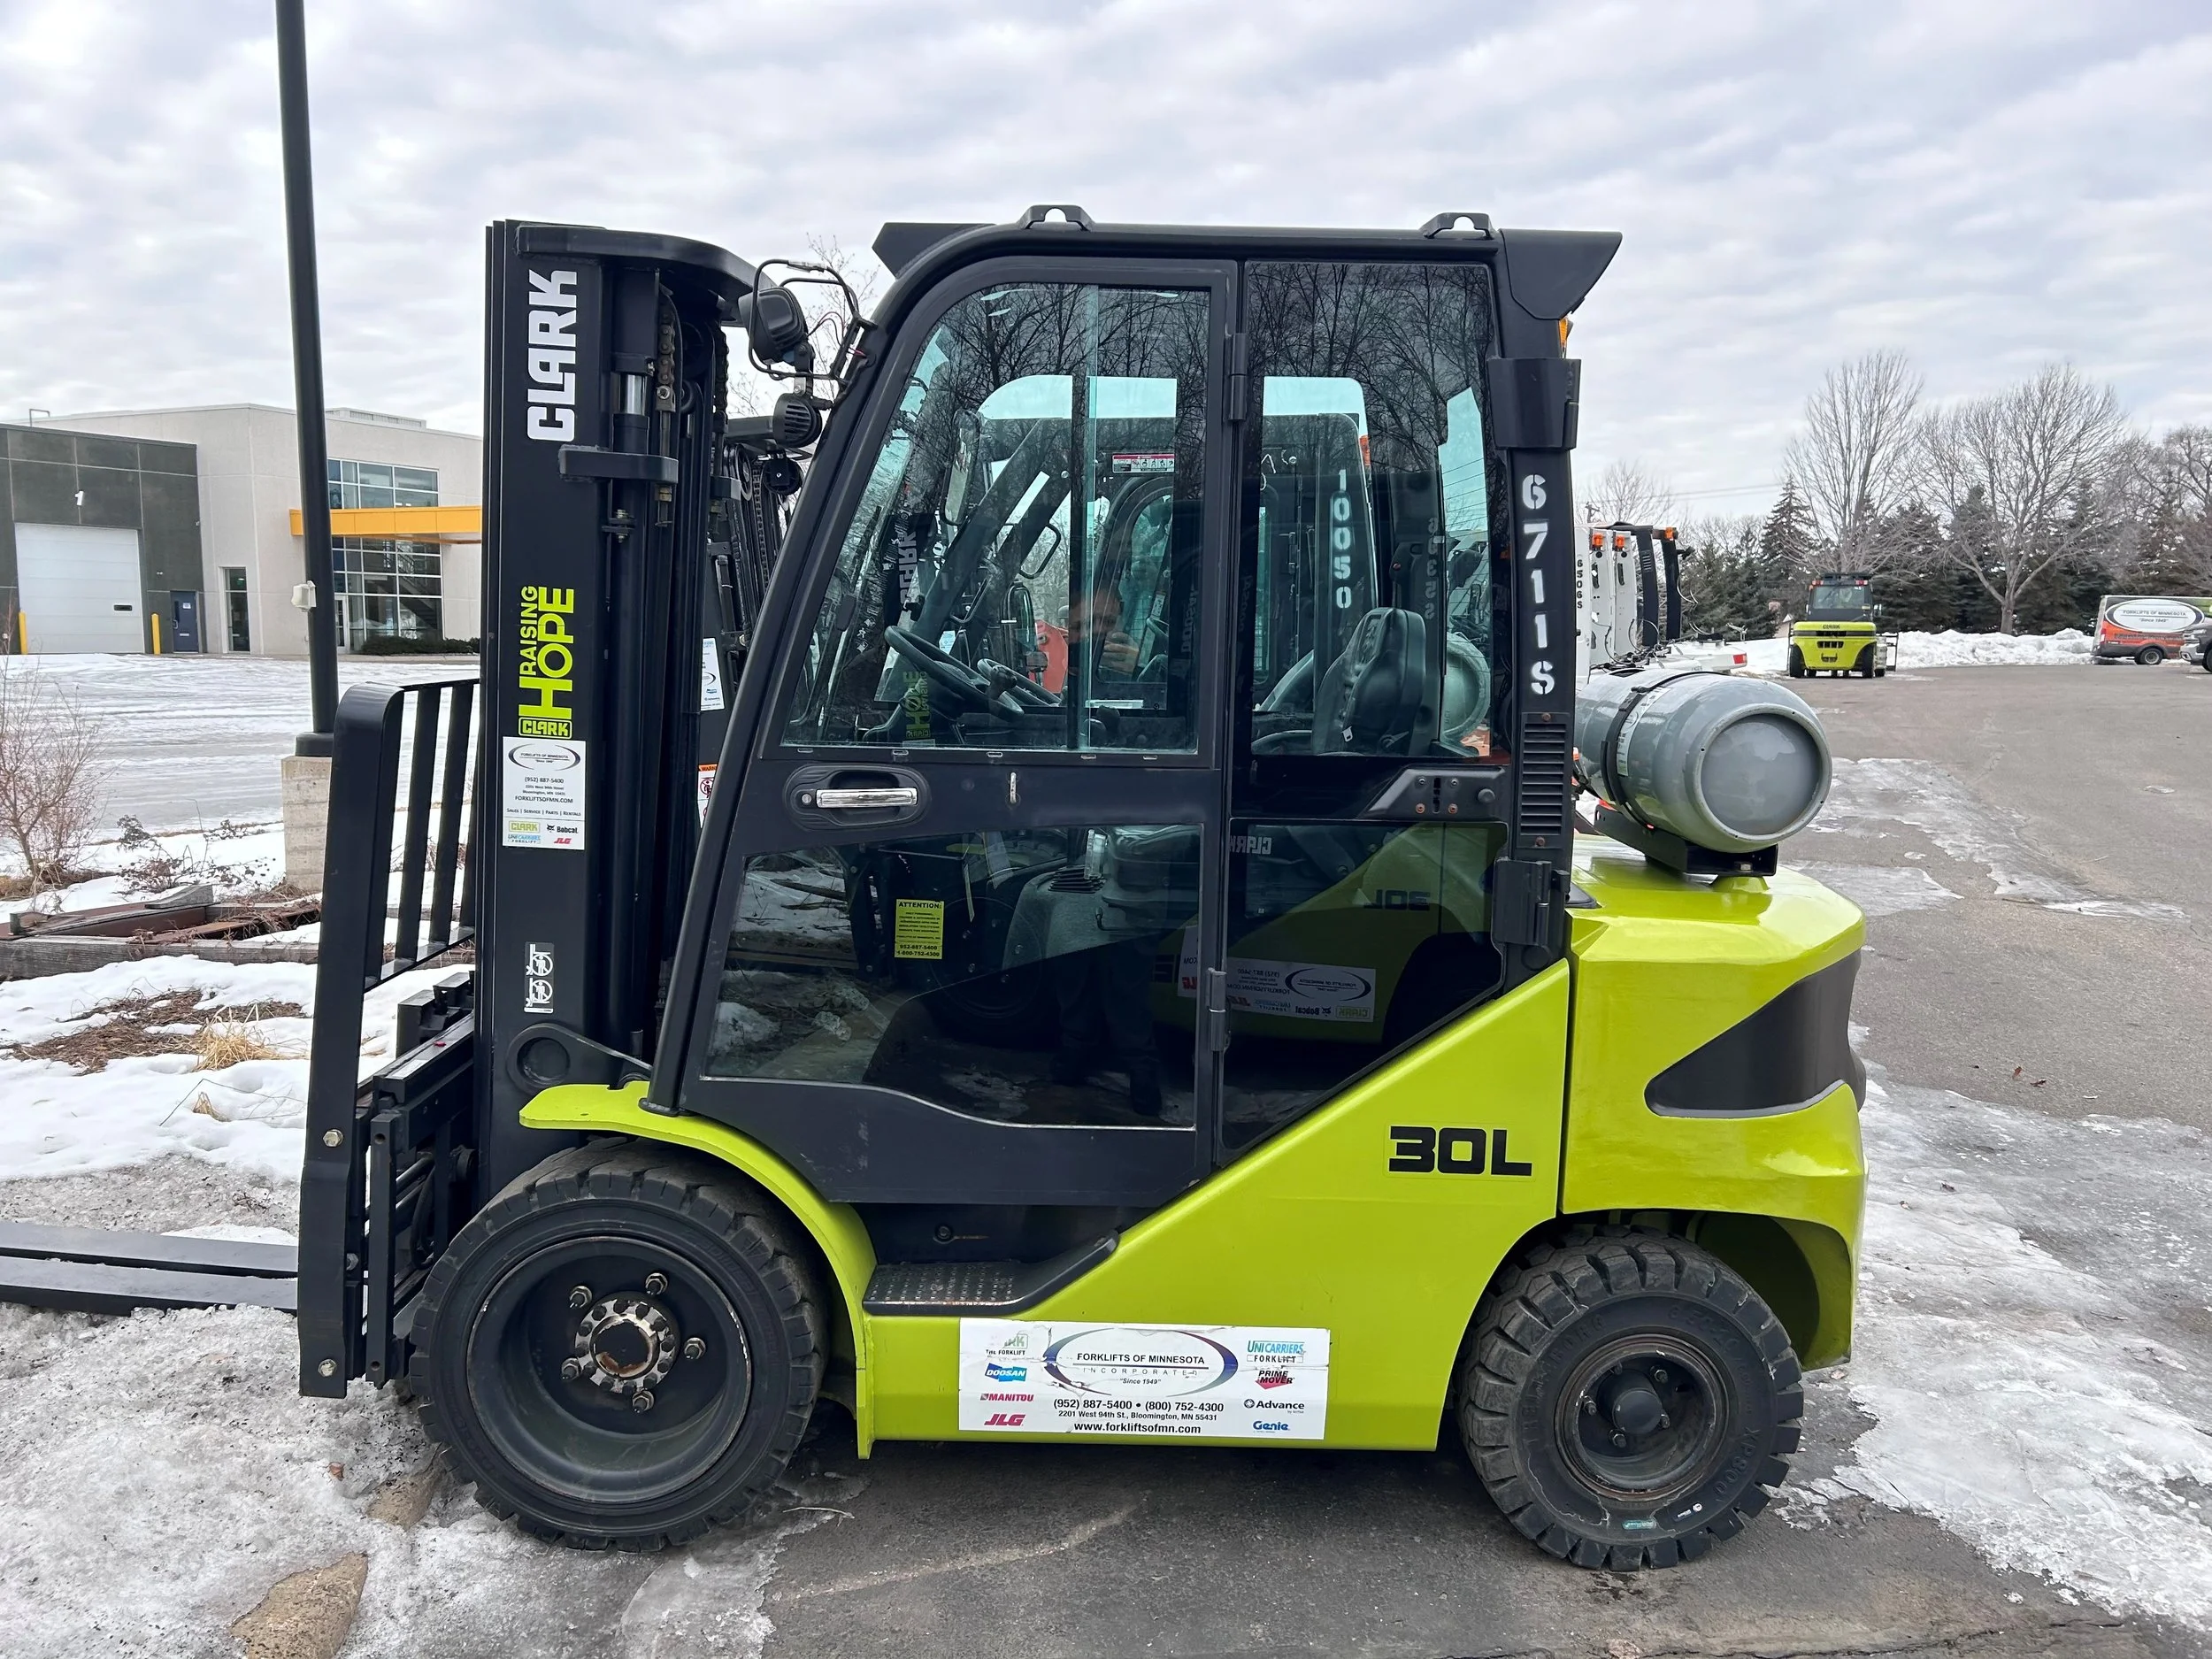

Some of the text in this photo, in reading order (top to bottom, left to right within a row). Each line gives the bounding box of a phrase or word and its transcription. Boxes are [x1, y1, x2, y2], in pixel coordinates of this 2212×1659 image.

[527, 269, 577, 442] CLARK
[74, 490, 84, 506] 1
[1333, 469, 1351, 609] 10050
[1522, 474, 1555, 695] 6711S
[519, 586, 538, 676] RAISING
[518, 587, 574, 719] HOPE
[522, 719, 569, 737] CLARK
[511, 822, 538, 832] CLARK
[1389, 1125, 1532, 1176] 30L
[1077, 1352, 1205, 1364] FORKLIFTS OF MINNESOTA
[1260, 1376, 1294, 1385] MOVER
[988, 1393, 1034, 1402] MANITOU
[1053, 1399, 1225, 1412] (952) 887-5400 (800) 752-4300
[1256, 1400, 1305, 1409] Advance
[984, 1413, 1026, 1426] JLG
[1131, 1412, 1179, 1421] Bloomington,
[1074, 1422, 1202, 1433] www.forkliftsofmn.com
[1253, 1420, 1289, 1431] Genie
